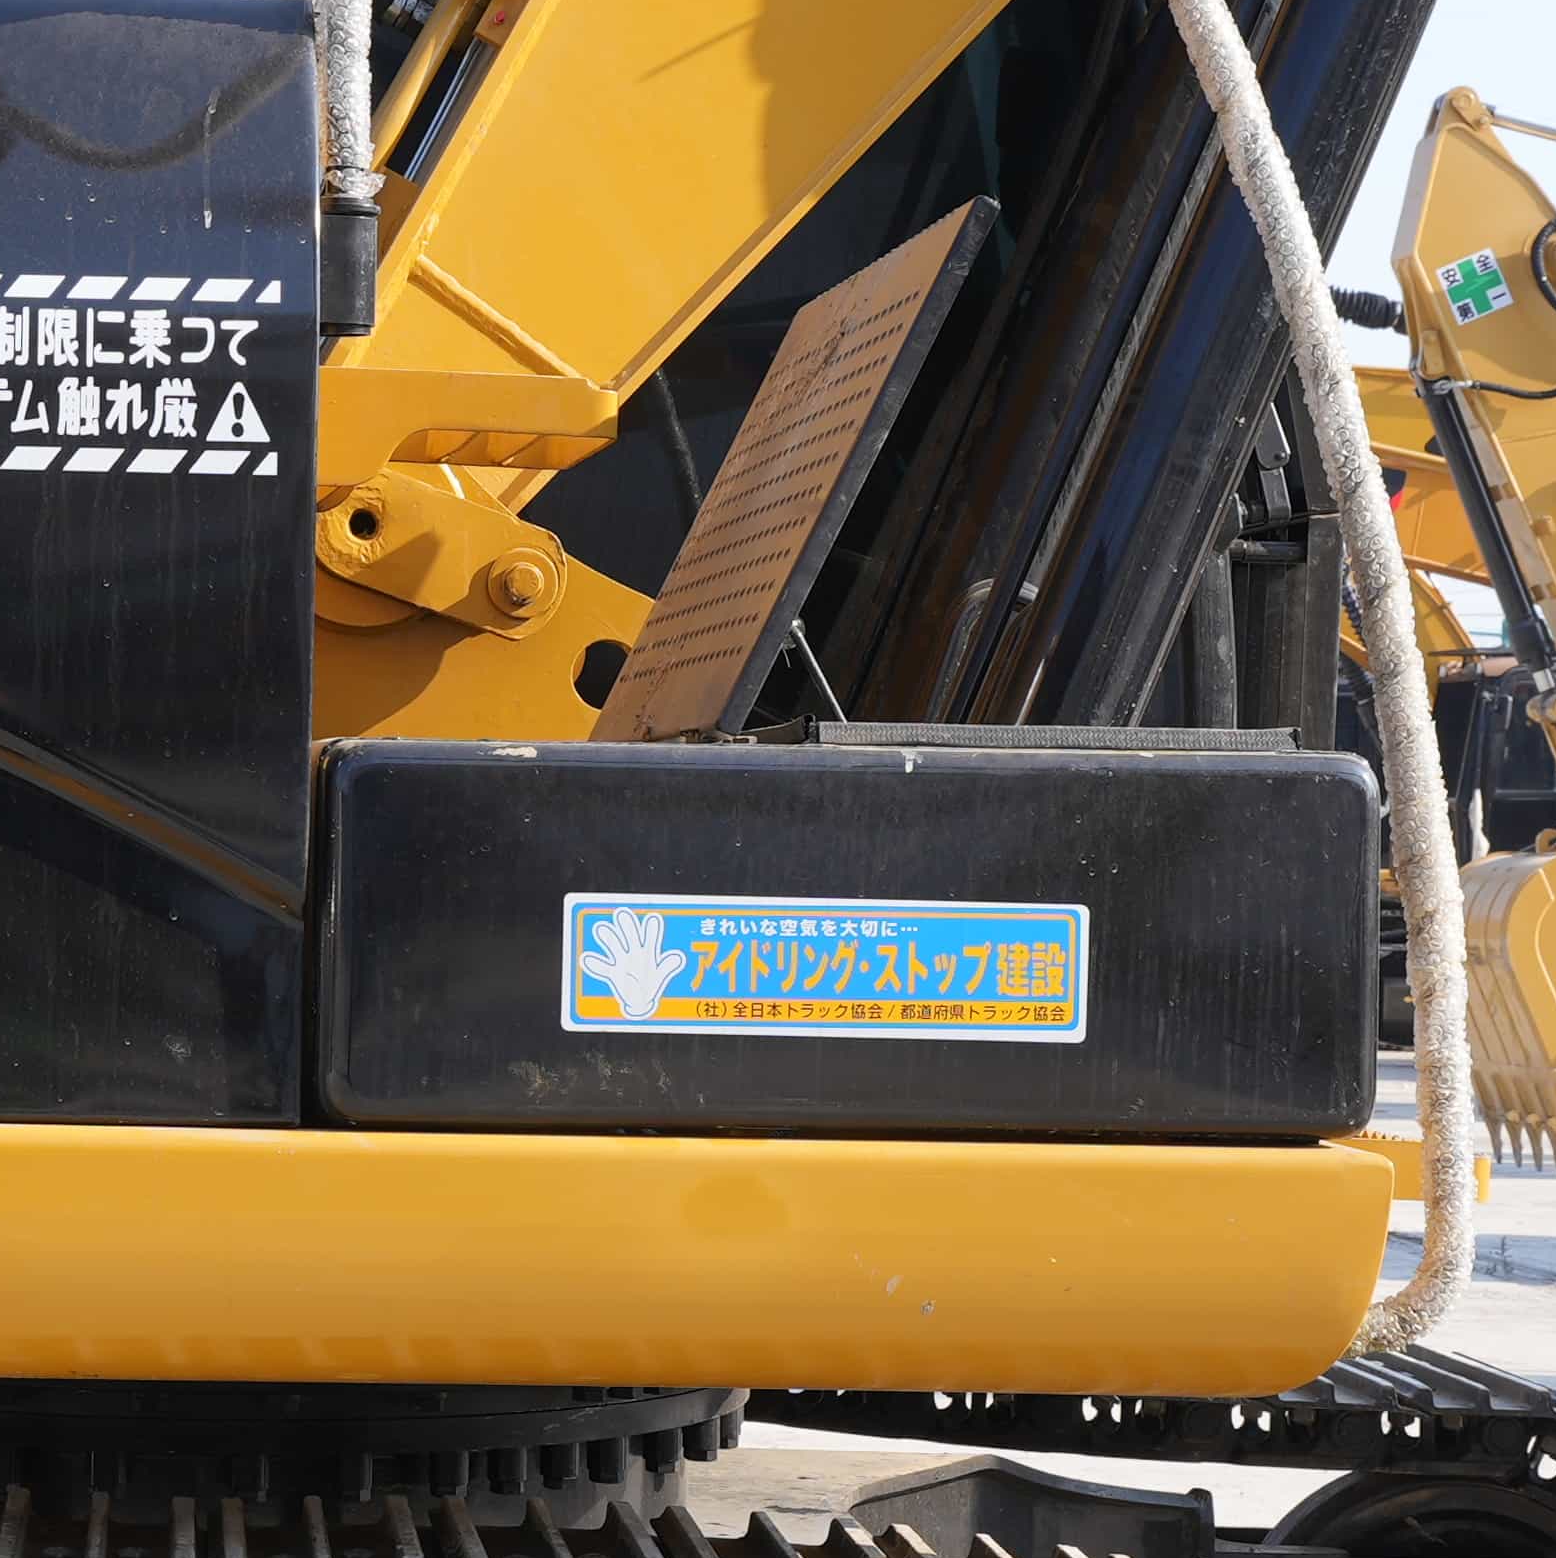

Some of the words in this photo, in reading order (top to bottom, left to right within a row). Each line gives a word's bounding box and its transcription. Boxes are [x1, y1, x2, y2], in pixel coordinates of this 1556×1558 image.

[900, 1006, 1066, 1023] 都道府県トラック協会
